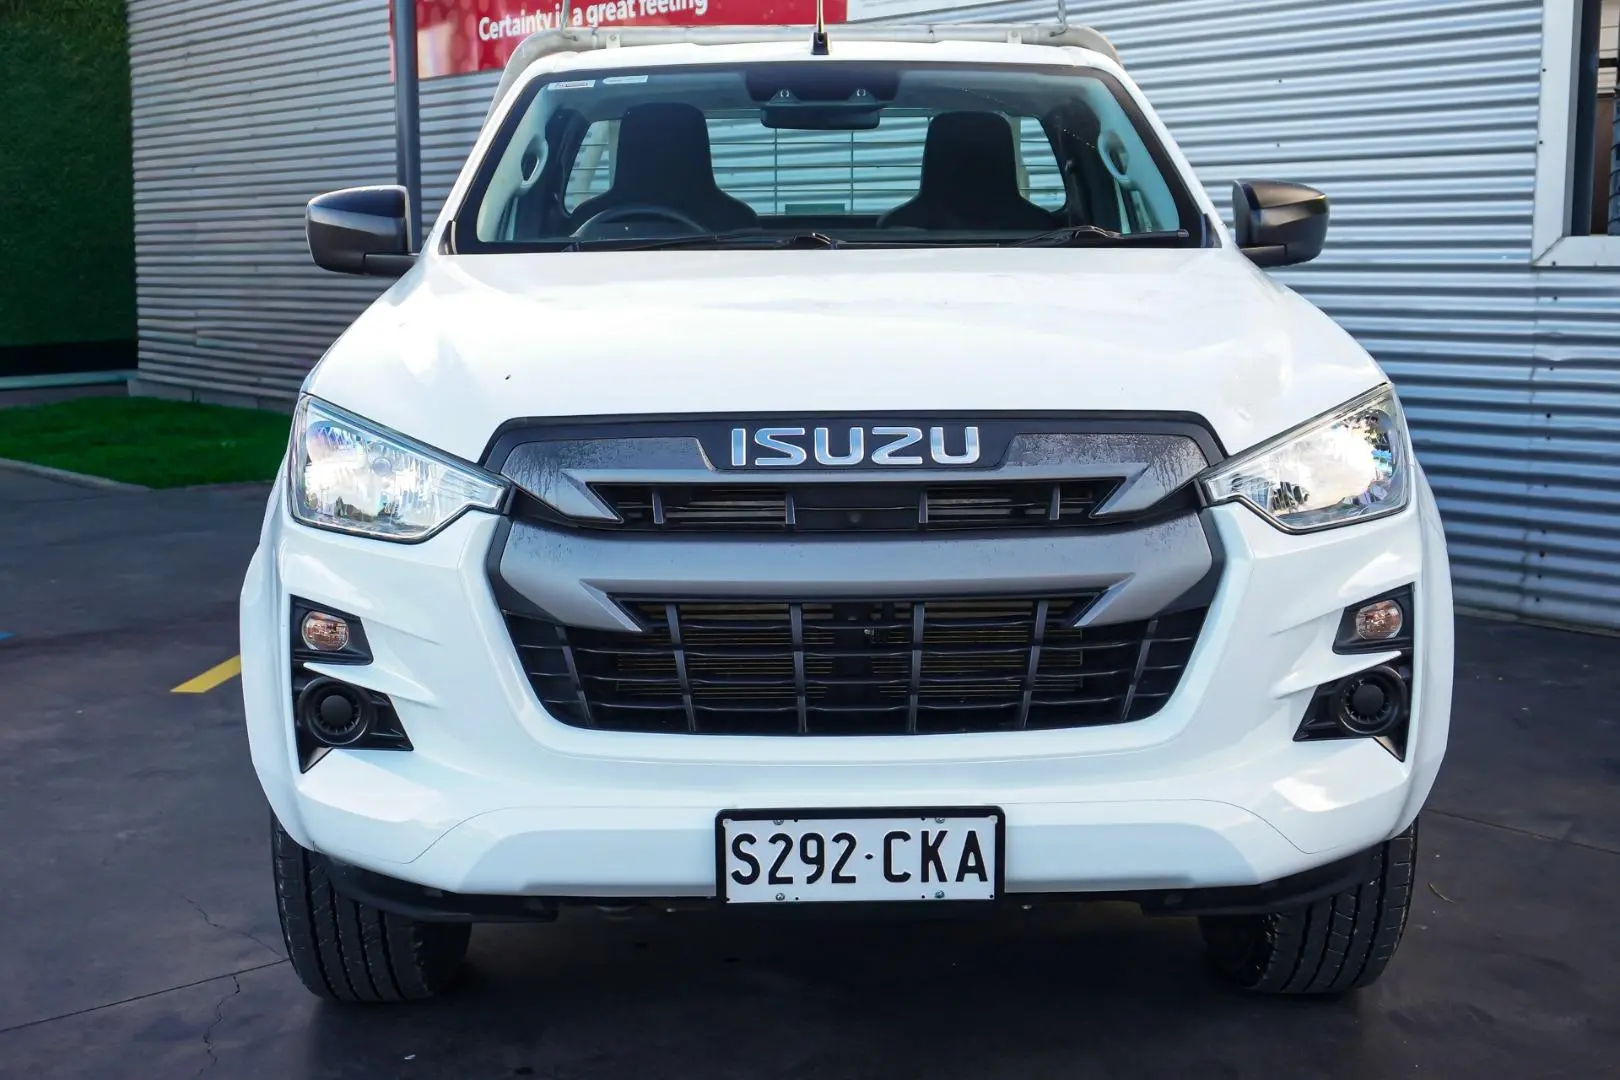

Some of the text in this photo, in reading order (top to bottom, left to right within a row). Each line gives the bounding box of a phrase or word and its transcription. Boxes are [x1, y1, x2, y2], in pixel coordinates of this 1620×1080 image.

[478, 8, 553, 41] Certainty
[572, 7, 584, 26] a
[586, 0, 637, 28] great
[731, 426, 981, 466] ISUZU
